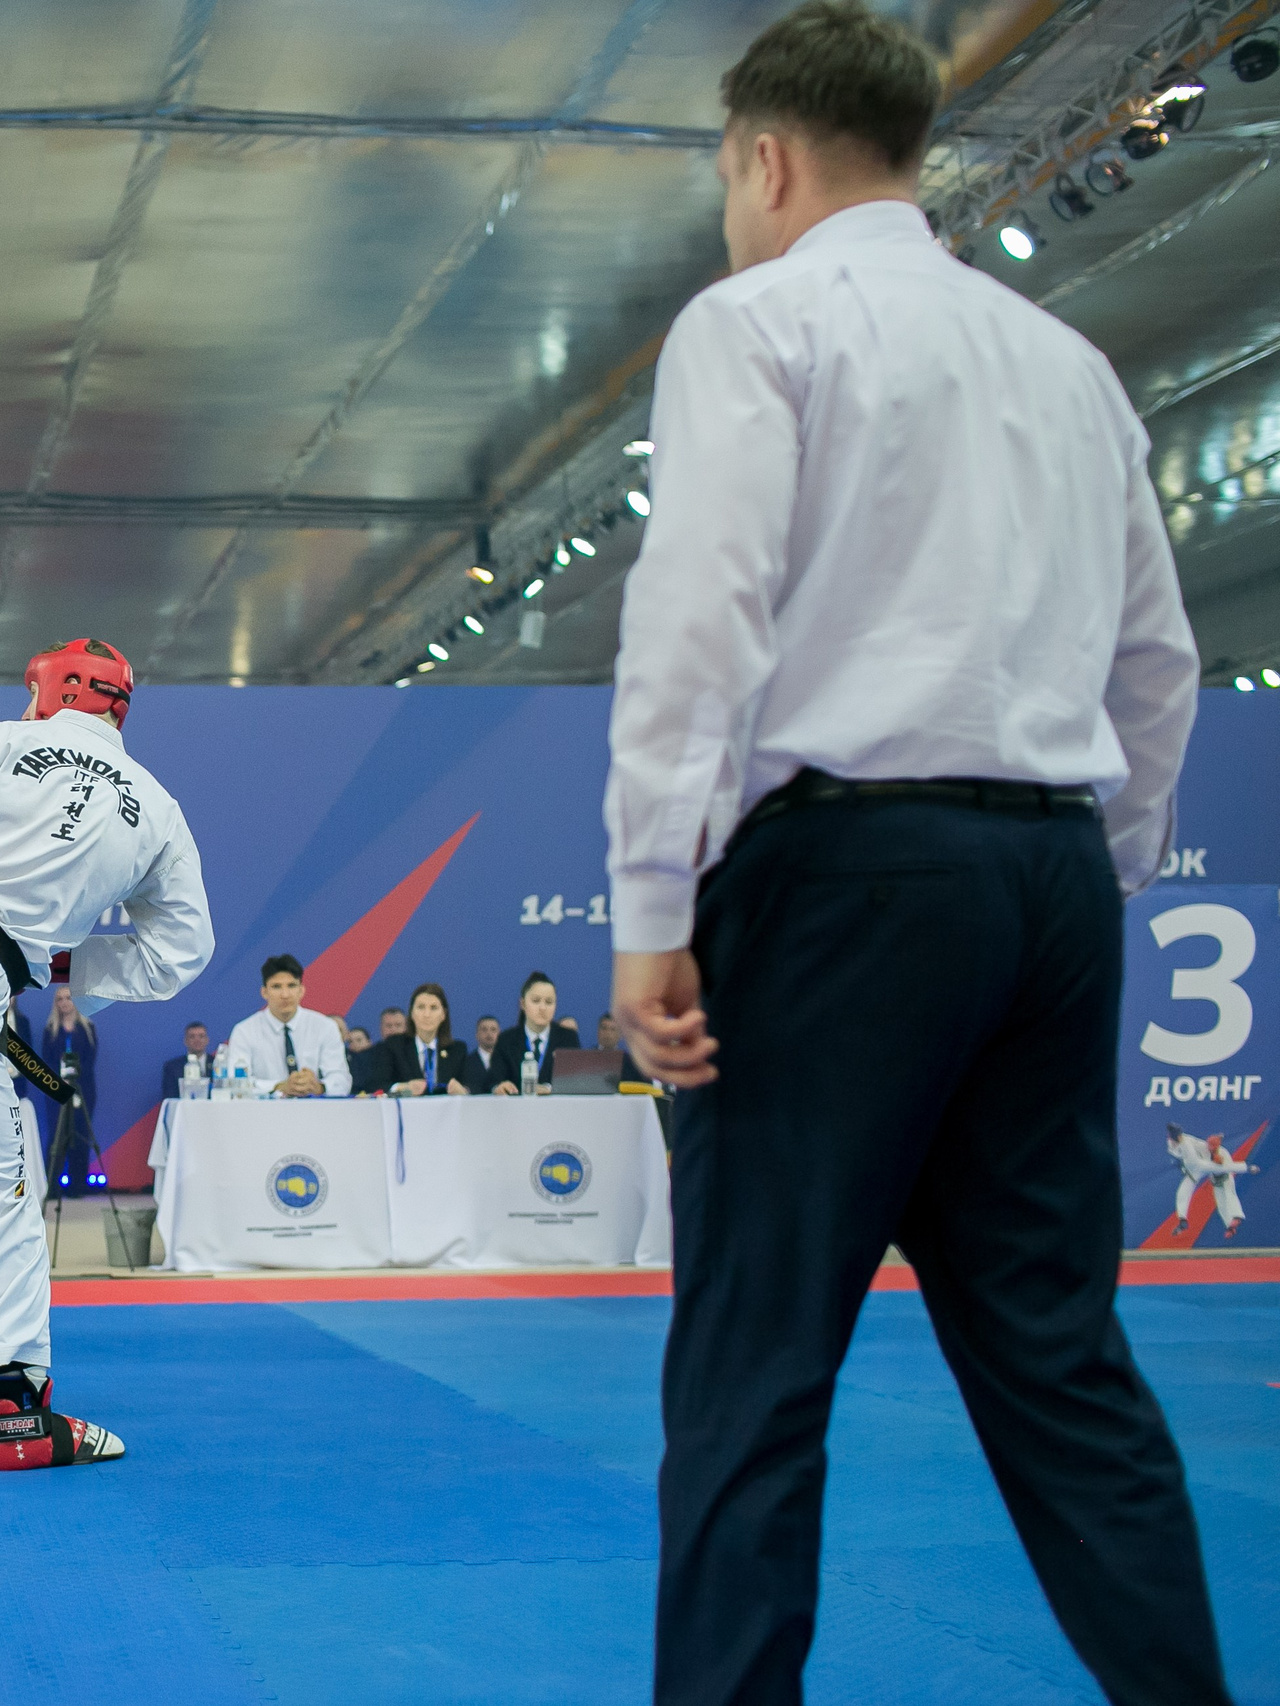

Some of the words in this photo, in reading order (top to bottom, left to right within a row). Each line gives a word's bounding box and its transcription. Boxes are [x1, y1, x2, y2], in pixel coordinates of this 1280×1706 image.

[12, 747, 140, 828] TAEKWON-DO
[74, 769, 100, 783] ITF
[520, 893, 610, 925] 14-1
[1140, 903, 1256, 1067] 3
[1144, 1075, 1262, 1107] ДОЯНГ
[0, 1419, 35, 1431] TENDAN
